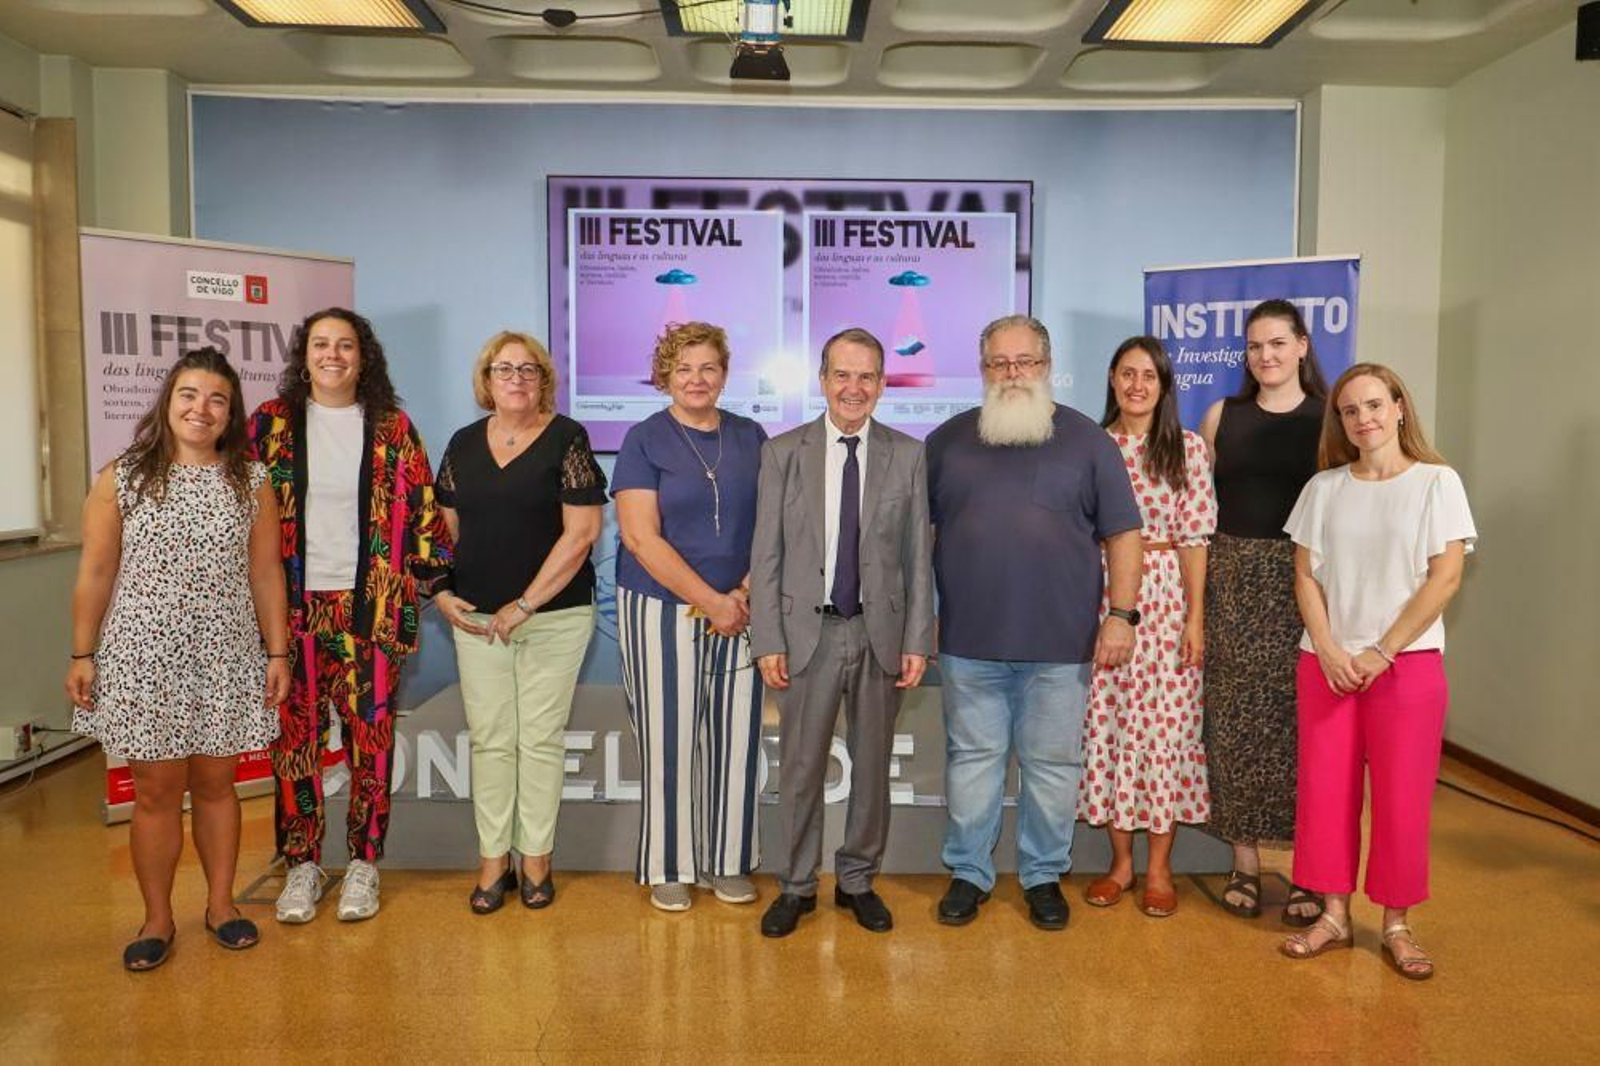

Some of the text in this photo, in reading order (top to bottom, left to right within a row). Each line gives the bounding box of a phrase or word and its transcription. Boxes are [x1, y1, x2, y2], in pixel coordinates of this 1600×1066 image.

[579, 217, 742, 247] III FESTIVAL
[814, 219, 975, 248] III FESTIVAL
[190, 276, 239, 287] CONCELLO
[196, 285, 234, 296] DE VIGO
[1152, 296, 1348, 340] INSTITO
[101, 311, 304, 363] III FESTIV
[103, 361, 129, 376] das
[135, 362, 169, 381] ling
